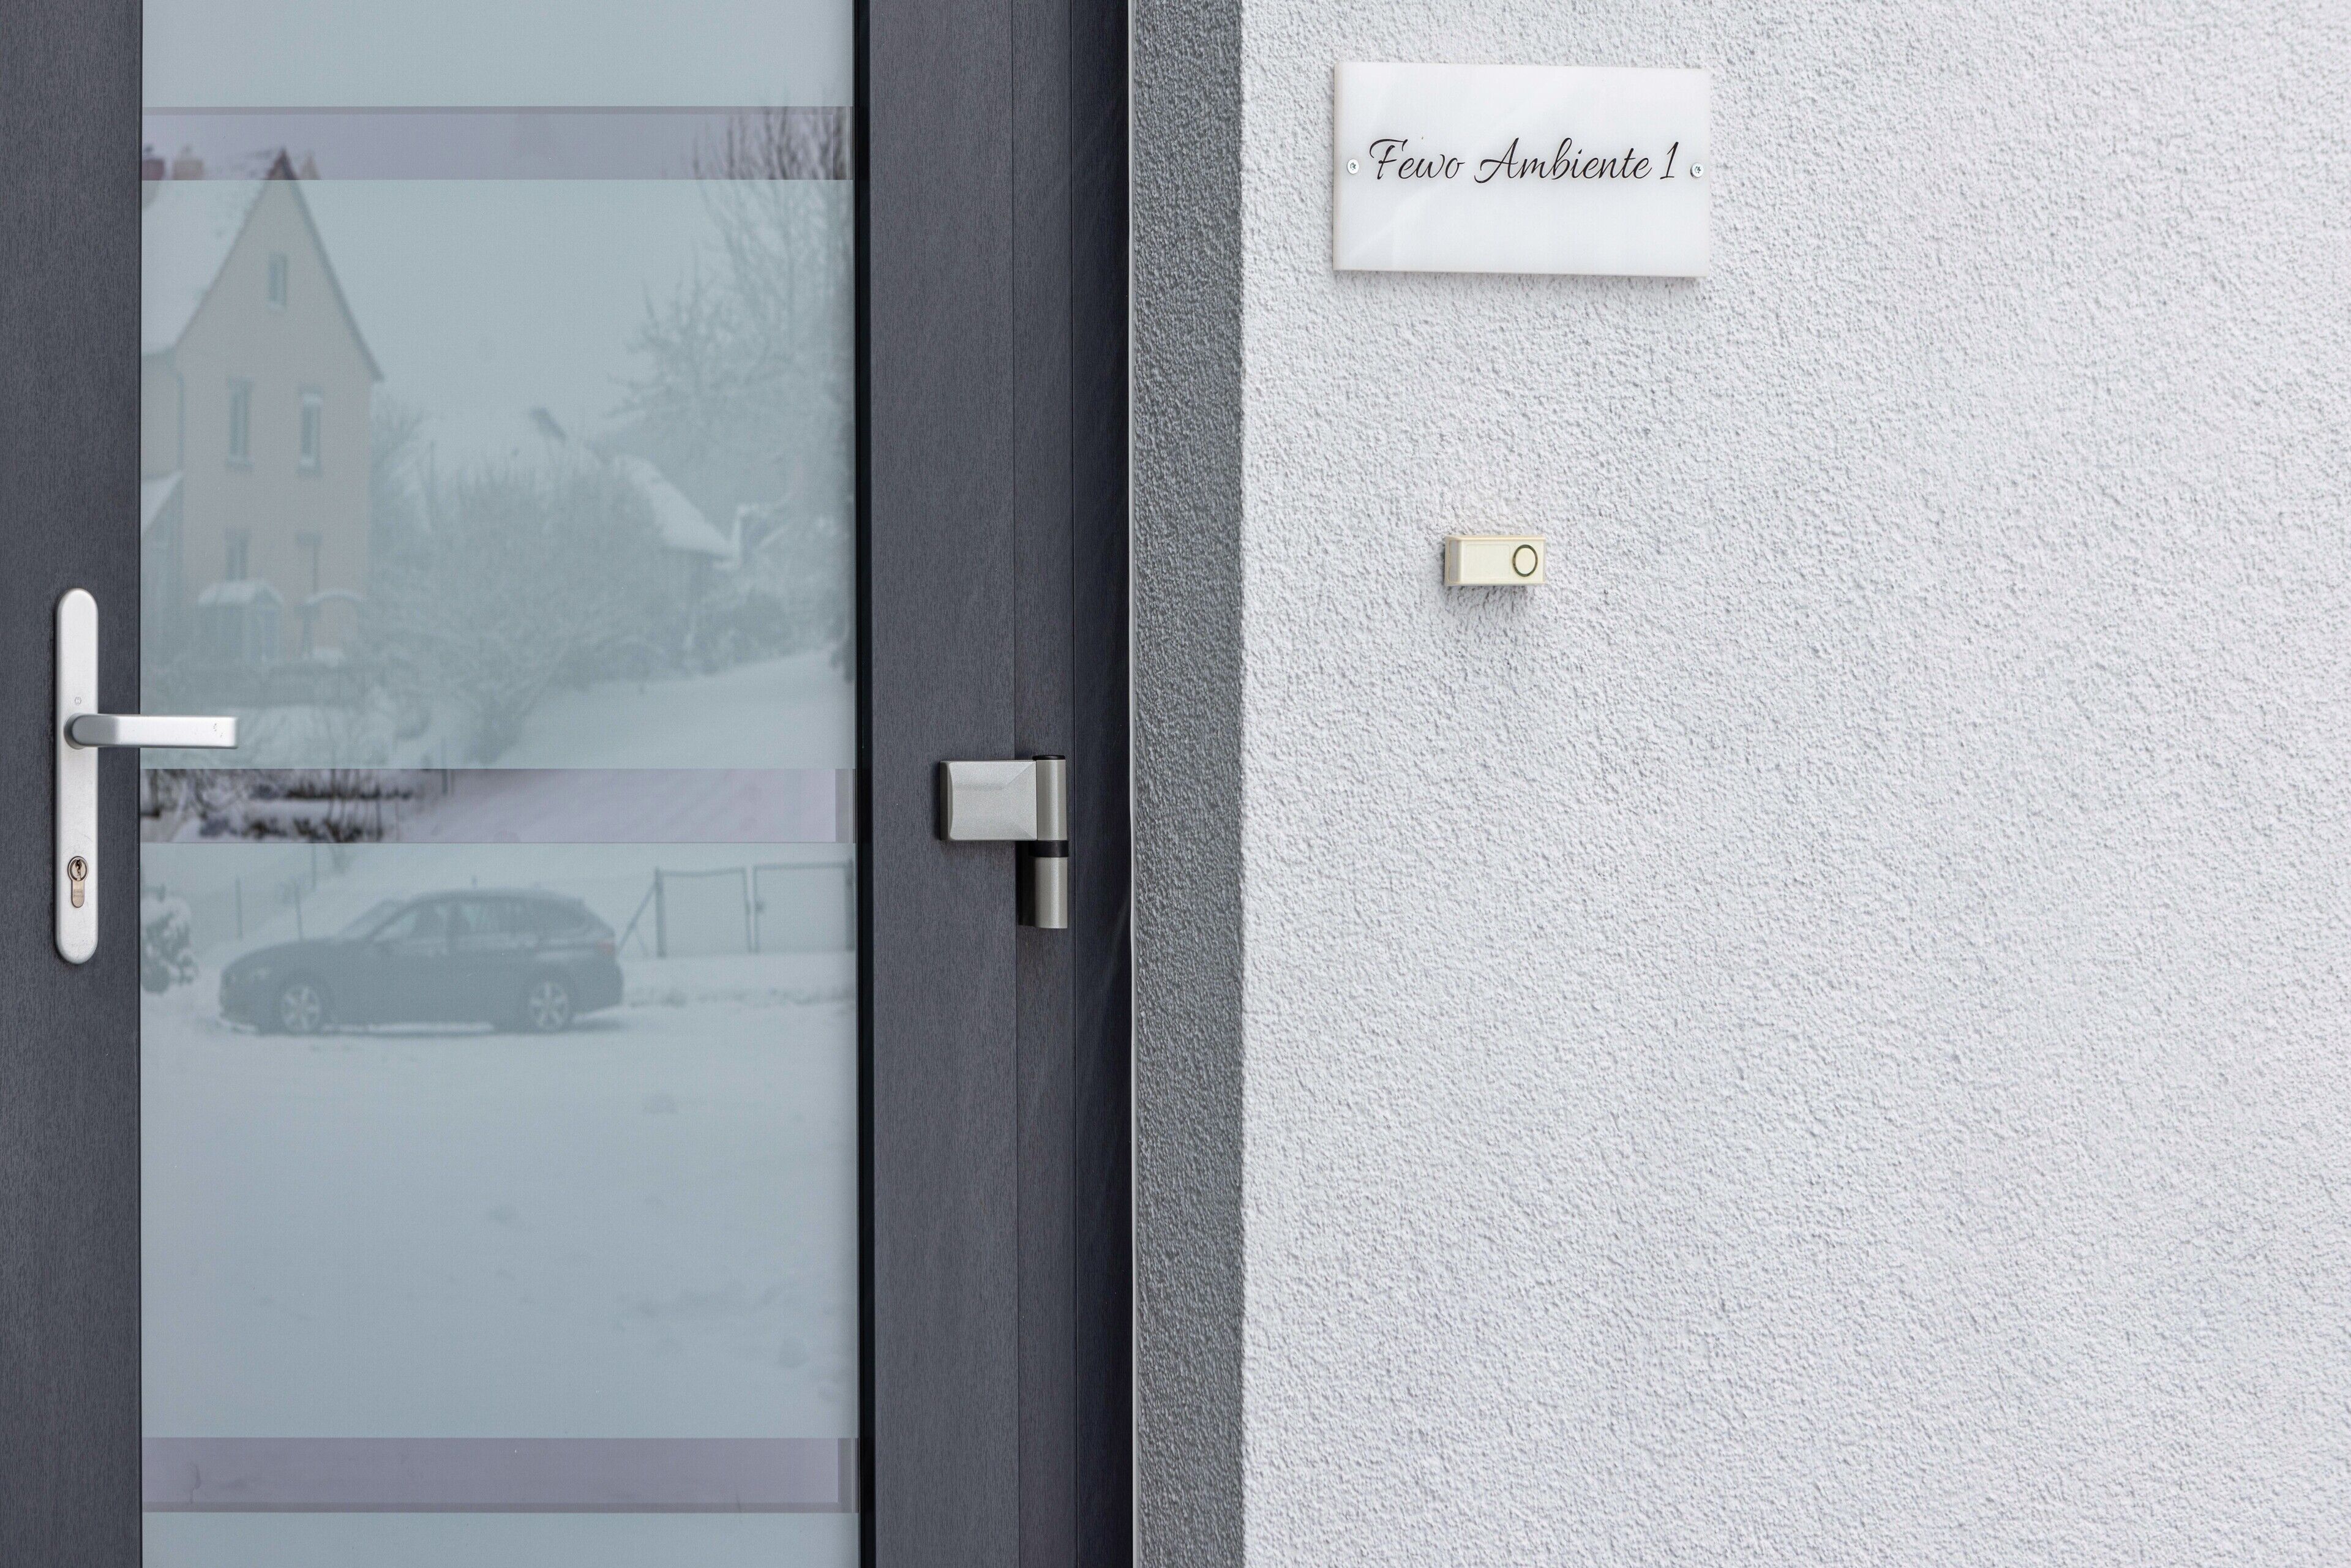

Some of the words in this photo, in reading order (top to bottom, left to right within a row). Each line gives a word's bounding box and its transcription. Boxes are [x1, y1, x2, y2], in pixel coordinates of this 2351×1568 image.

[1369, 138, 1466, 180] Fewo
[1474, 137, 1653, 184] Ambiente
[1660, 141, 1679, 180] 1
